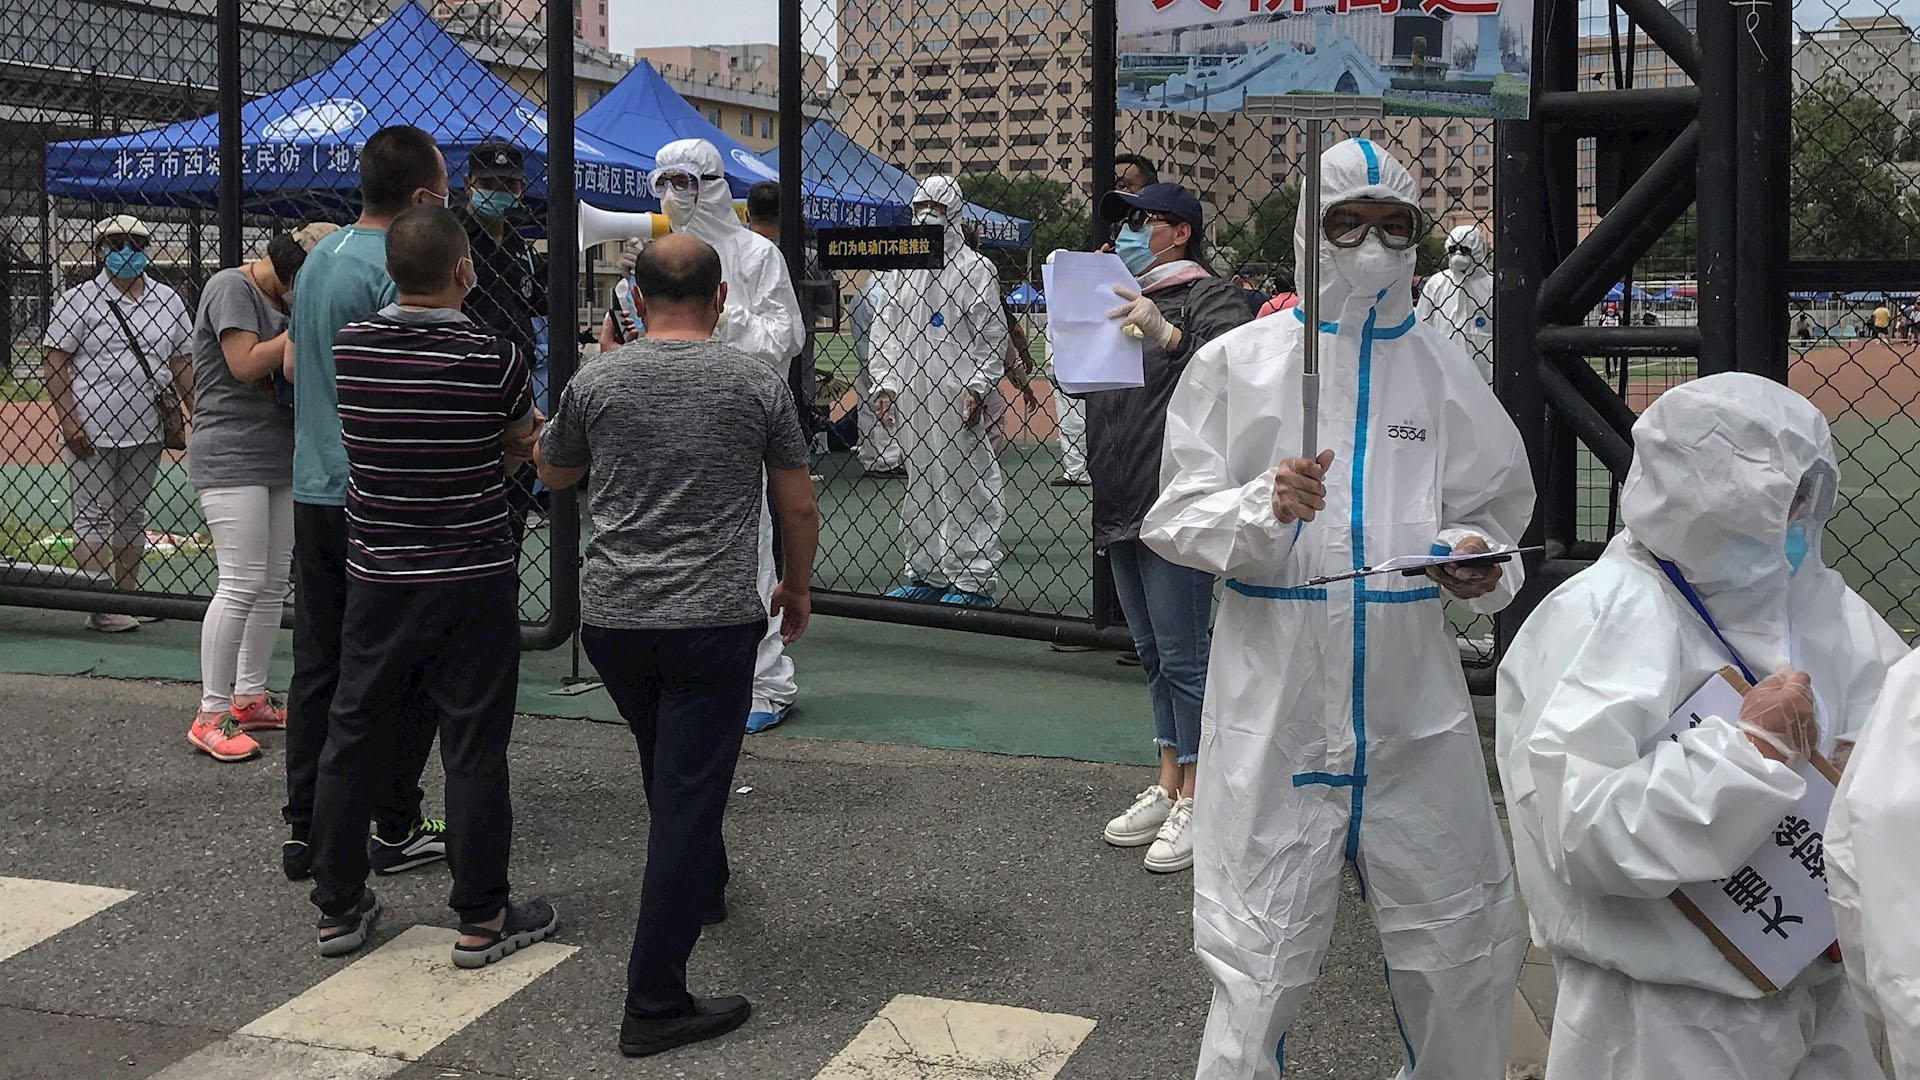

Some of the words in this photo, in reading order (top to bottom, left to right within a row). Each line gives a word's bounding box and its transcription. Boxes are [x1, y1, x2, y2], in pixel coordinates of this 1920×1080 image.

[828, 238, 930, 256] 此门为电动门不能推拉
[1711, 864, 1804, 940] 大栅
